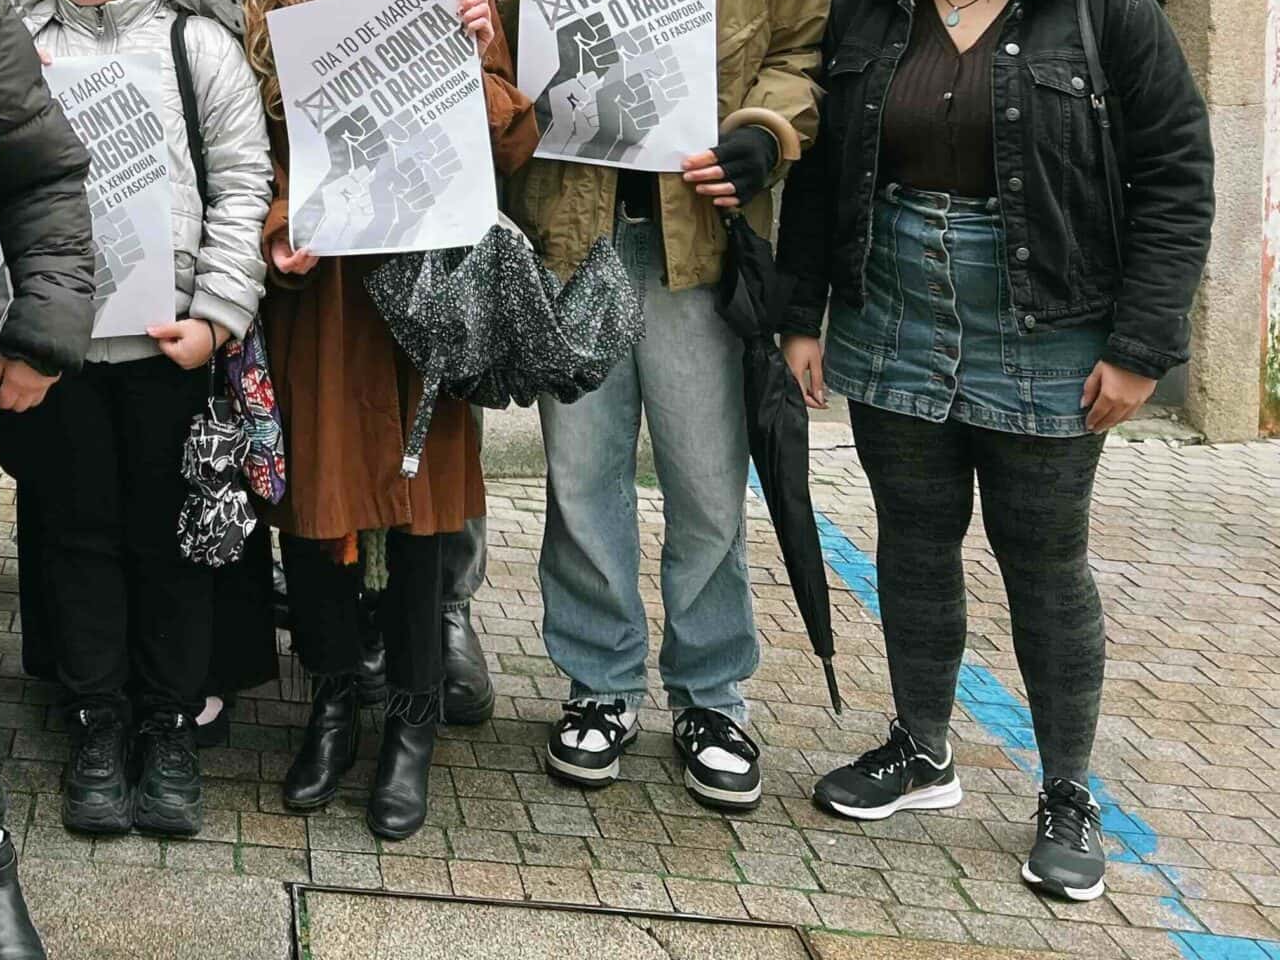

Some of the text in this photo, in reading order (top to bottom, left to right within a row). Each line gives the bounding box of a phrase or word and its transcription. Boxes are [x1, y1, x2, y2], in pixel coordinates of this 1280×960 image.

[607, 0, 630, 28] O
[647, 0, 705, 32] A XENOFOBIA
[654, 11, 713, 45] E O FASCISMO
[311, 51, 342, 77] DIA
[336, 37, 359, 57] 10
[355, 22, 380, 45] DE
[326, 3, 460, 107] VOTA CONTRA
[369, 26, 476, 118] O RACISMO
[71, 60, 126, 105] MARÇO
[412, 70, 470, 114] A XENOFOBIA
[421, 78, 480, 126] E O FASCISMO
[71, 82, 151, 145] CONTRA
[99, 154, 158, 195] A XENOFOBIA
[106, 164, 167, 209] E O FASCISMO
